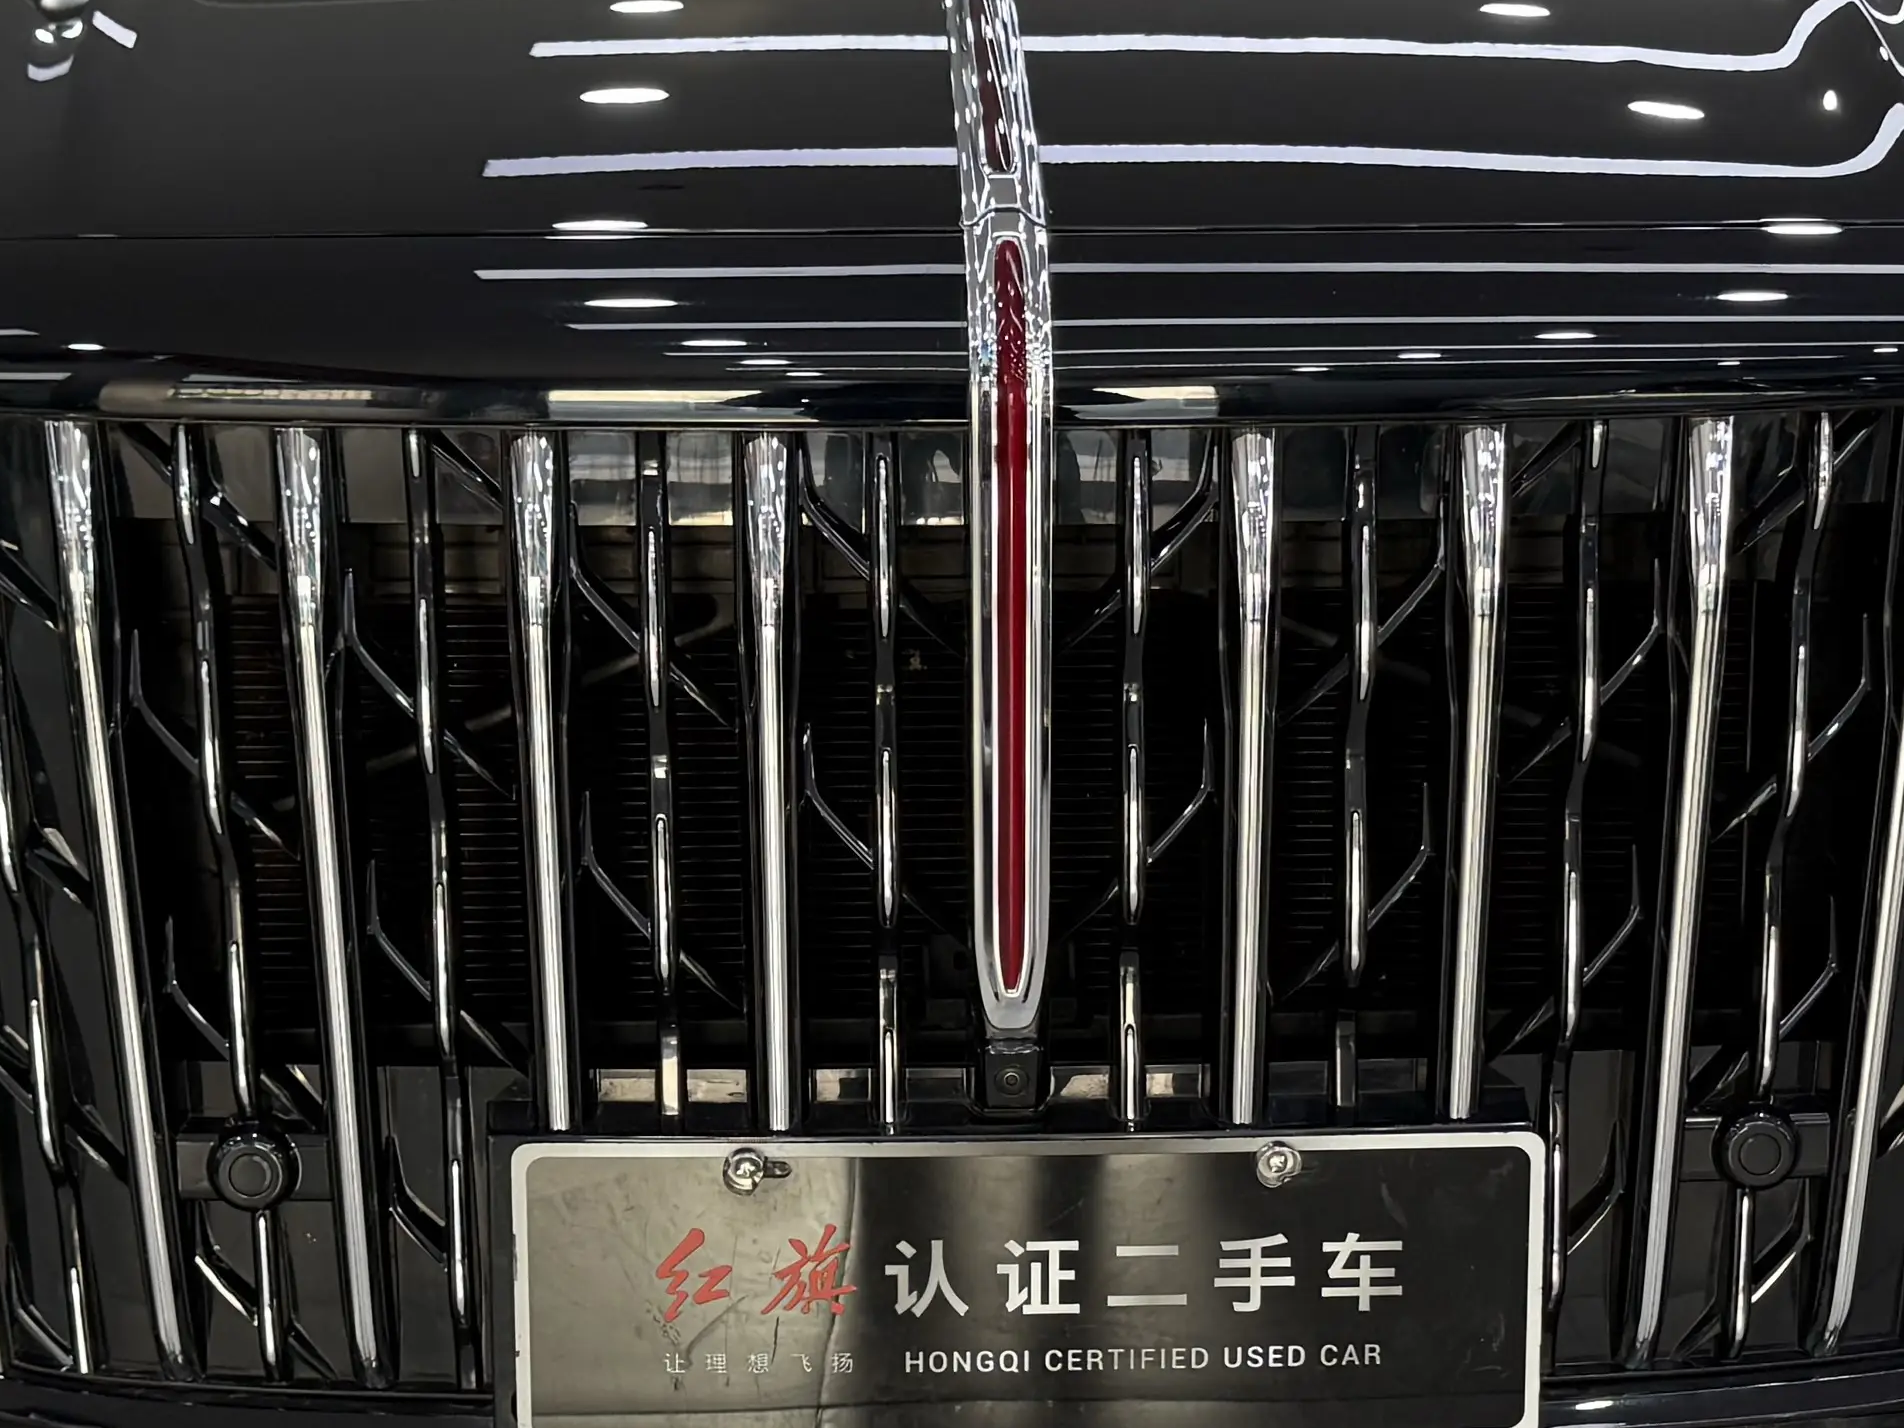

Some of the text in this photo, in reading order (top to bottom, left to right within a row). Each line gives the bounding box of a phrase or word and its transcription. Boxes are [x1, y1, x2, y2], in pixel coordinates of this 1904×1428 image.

[663, 1353, 854, 1373] 让理想飞扬
[904, 1343, 1382, 1373] HONGQI CERTIFIED USED CAR
